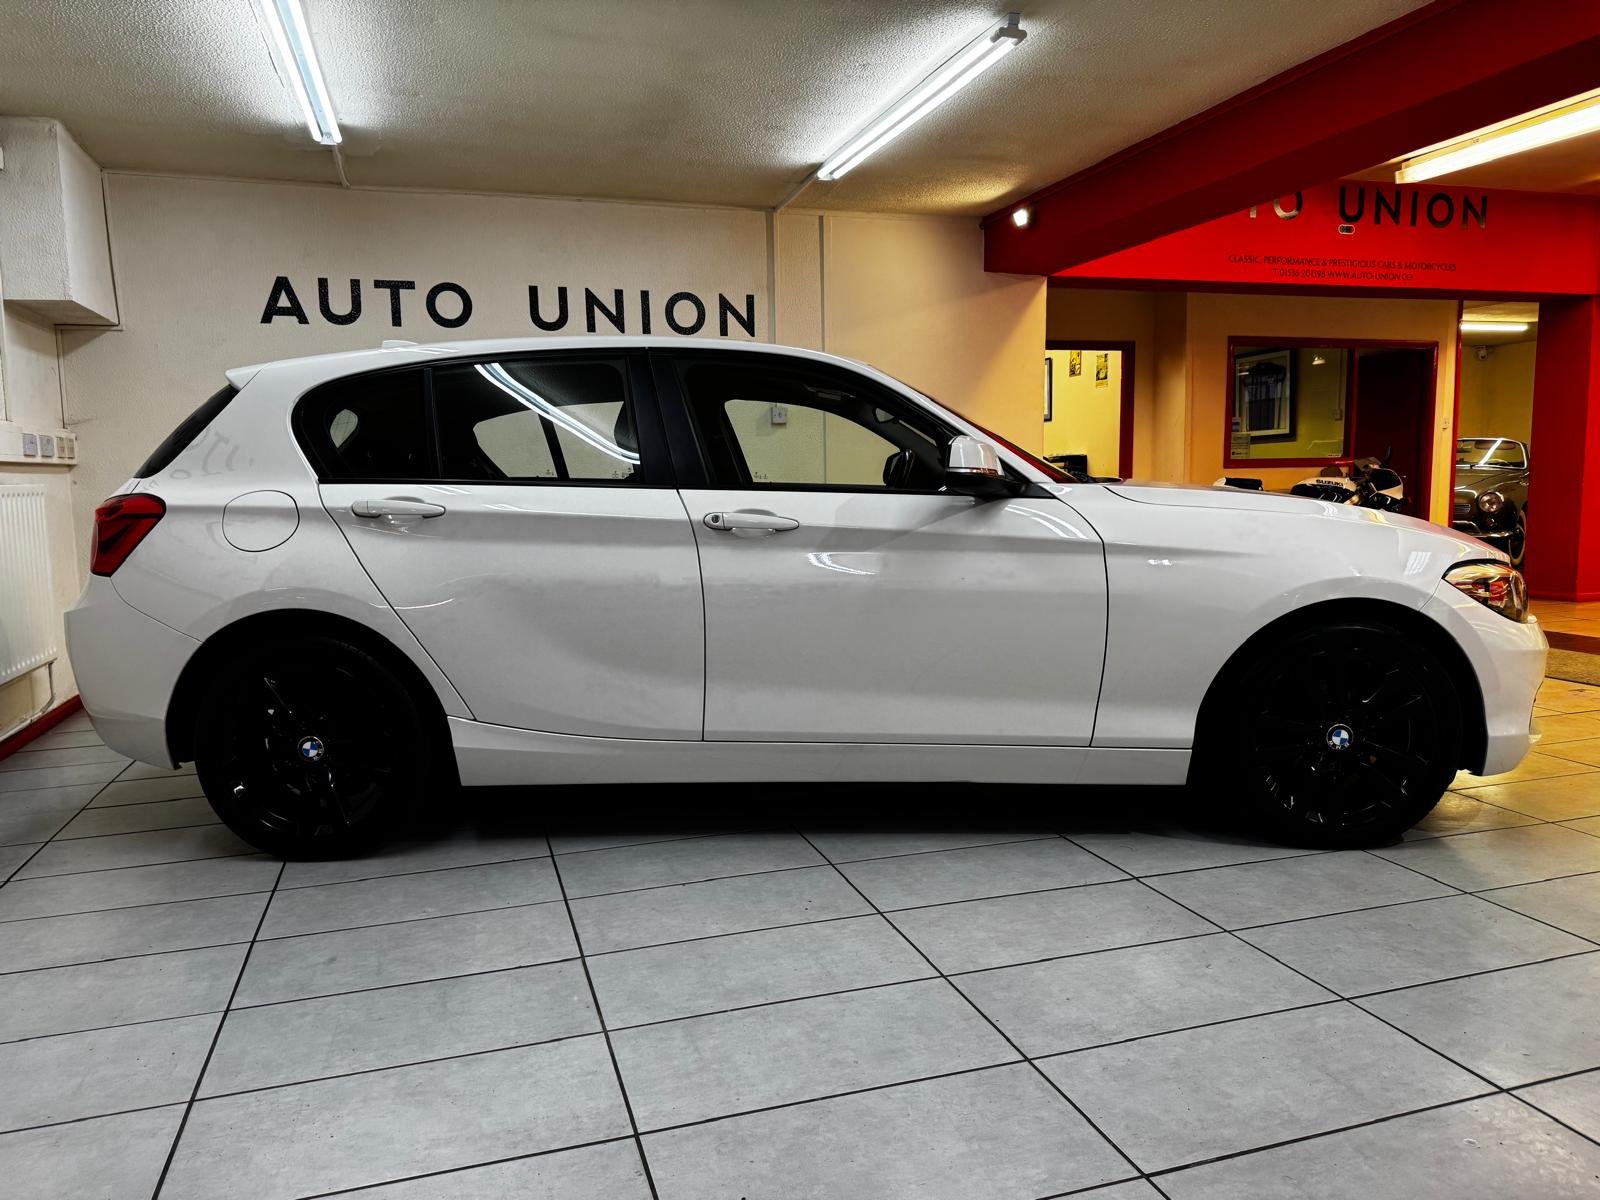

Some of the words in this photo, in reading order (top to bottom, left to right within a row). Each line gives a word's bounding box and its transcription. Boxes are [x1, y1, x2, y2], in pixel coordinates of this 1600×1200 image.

[1339, 186, 1488, 230] UNION
[1263, 256, 1321, 267] PERFORMANCE
[1322, 259, 1328, 267] &
[1329, 259, 1377, 269] PRESTIGIOUS
[1378, 260, 1397, 269] CARS
[1404, 262, 1457, 272] MOTORCYCLES
[260, 276, 473, 328] AUTO
[528, 285, 755, 337] UNION
[1315, 479, 1344, 487] SUZUKI
